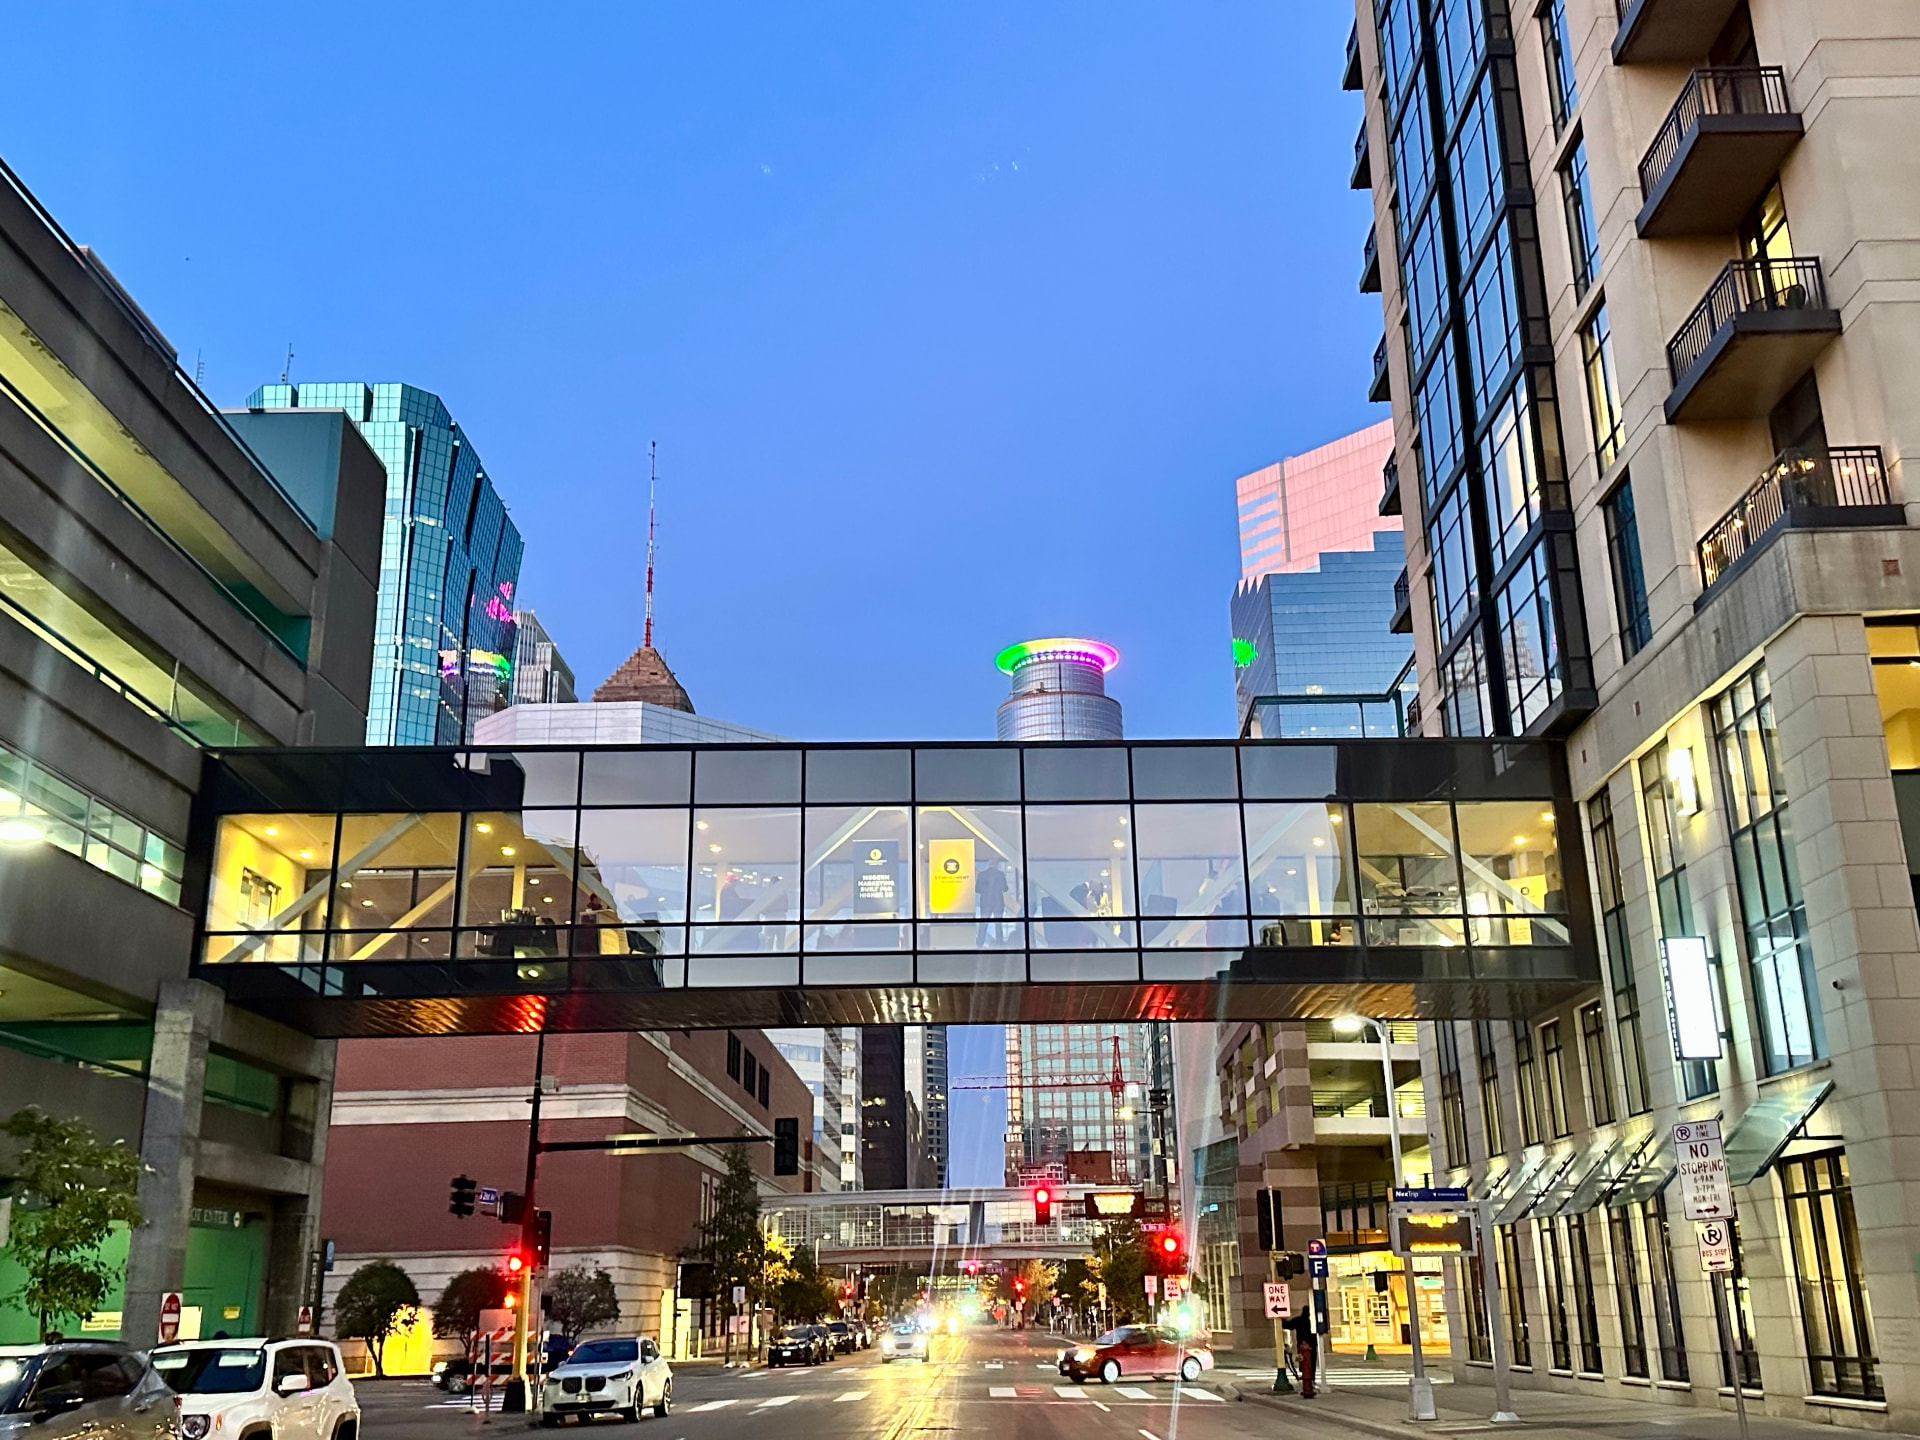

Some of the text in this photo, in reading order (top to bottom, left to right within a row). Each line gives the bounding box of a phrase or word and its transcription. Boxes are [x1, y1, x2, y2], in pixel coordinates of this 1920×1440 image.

[1665, 981, 1674, 1009] SPA
[1695, 1124, 1707, 1132] ANY
[1695, 1130, 1710, 1138] TIME
[1689, 1143, 1709, 1159] NO
[1681, 1161, 1723, 1175] STOPPING
[1693, 1193, 1721, 1203] MON-FRI
[203, 1209, 228, 1225] ENTER
[1714, 1248, 1728, 1257] STOP
[1314, 1261, 1323, 1274] F
[1268, 1285, 1285, 1295] ONE
[1268, 1294, 1287, 1304] WAY
